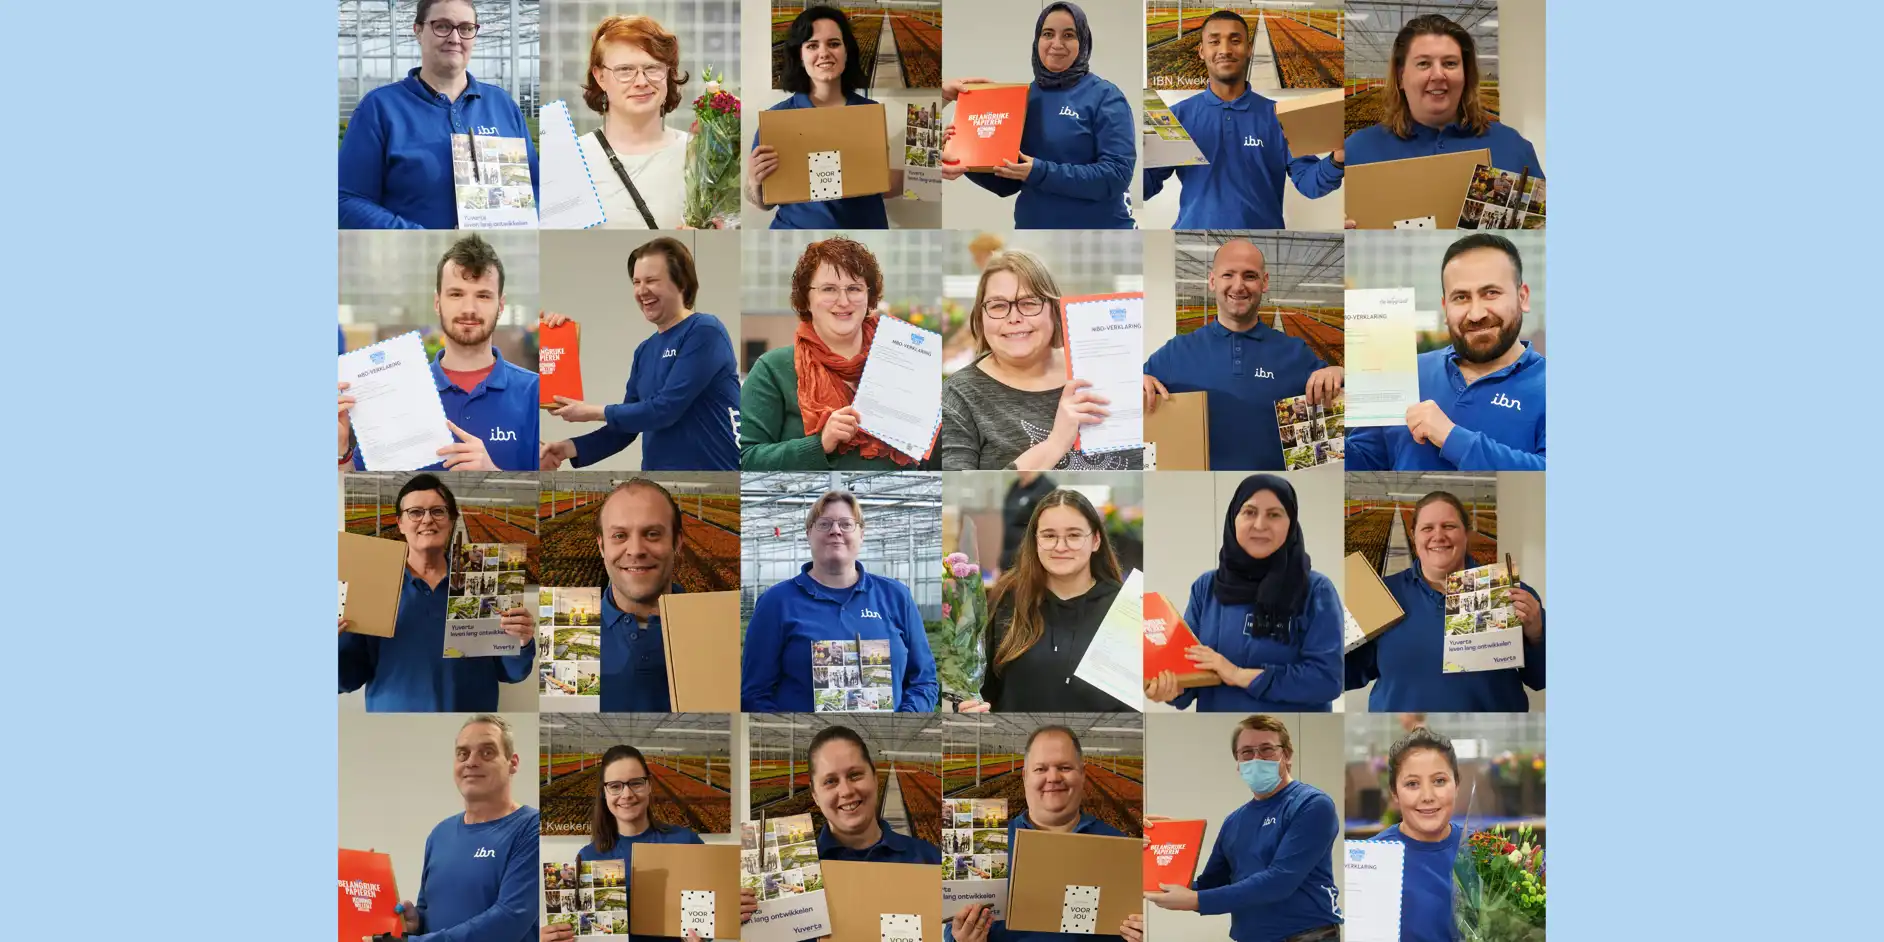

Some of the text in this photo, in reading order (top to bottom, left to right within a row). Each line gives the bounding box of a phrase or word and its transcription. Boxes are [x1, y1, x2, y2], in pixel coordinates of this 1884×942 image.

[1153, 76, 1173, 86] IBN
[1058, 106, 1080, 119] ibn
[477, 125, 500, 135] ibn
[1243, 135, 1264, 147] ibn
[1344, 313, 1388, 321] BO-VERKLARING
[1091, 323, 1142, 332] MBO-VERKLARING
[891, 339, 932, 357] MBO-VERKLARING
[357, 360, 402, 378] MBO-VERKLARING
[1255, 367, 1275, 380] ibn
[1490, 392, 1522, 411] ibn
[489, 426, 518, 441] ibn
[860, 607, 883, 620] ibn
[1477, 640, 1512, 650] ontwikkelen
[1493, 655, 1517, 663] Yuverta
[473, 846, 496, 858] ibn
[344, 887, 377, 898] PAPIEREN
[943, 892, 997, 901] lang ontwikkelen
[754, 914, 770, 923] lang
[770, 906, 814, 920] ontwikkelen
[793, 923, 823, 934] Yuverta
